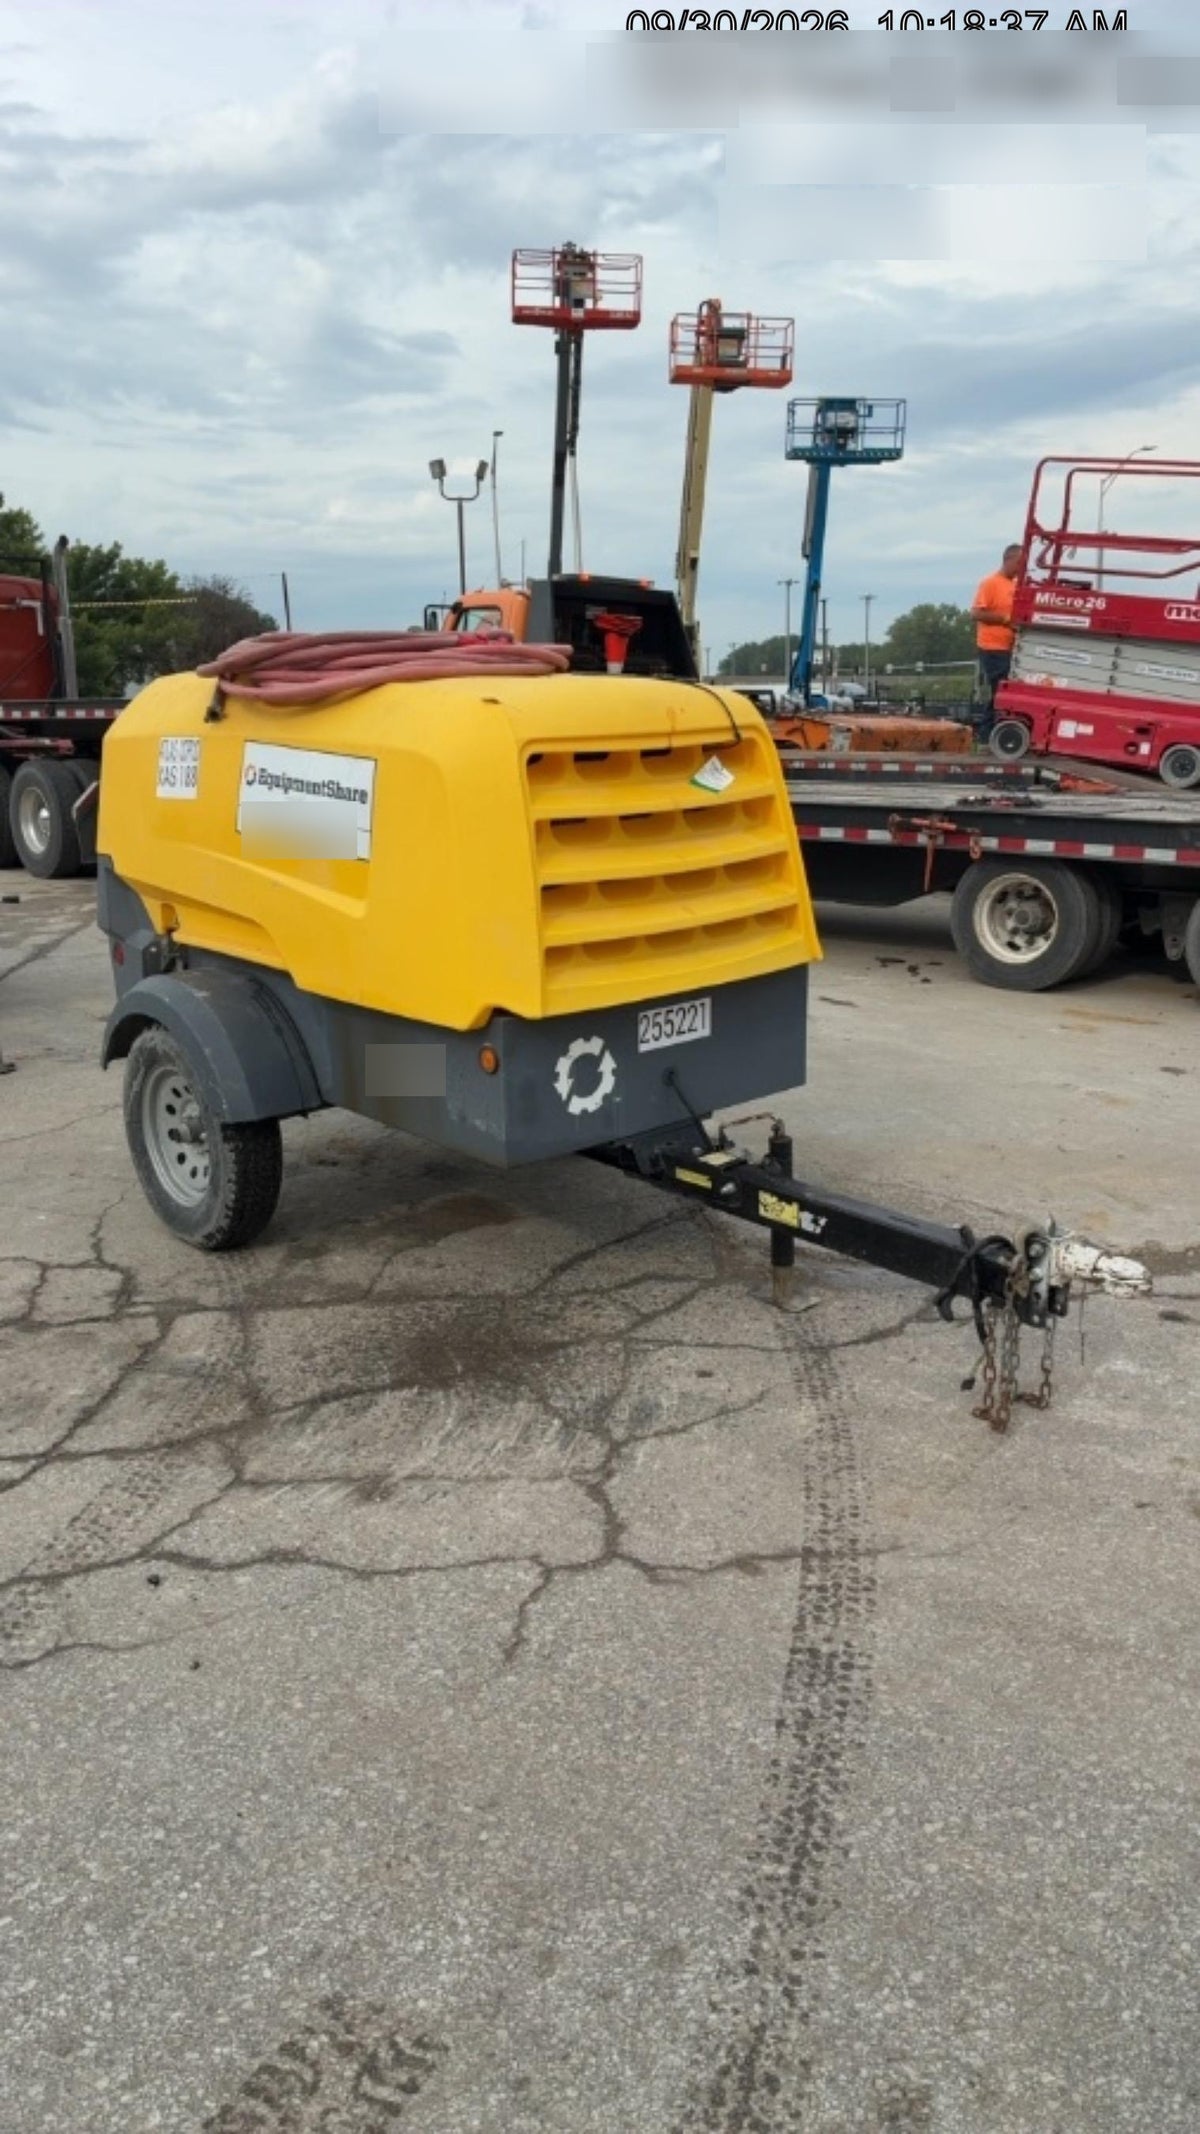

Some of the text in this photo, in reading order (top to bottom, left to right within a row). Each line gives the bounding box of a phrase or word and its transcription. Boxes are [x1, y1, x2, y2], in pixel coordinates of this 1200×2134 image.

[1036, 591, 1107, 610] Micro26
[257, 767, 369, 804] EquipmentShare
[639, 1002, 707, 1044] 255221
